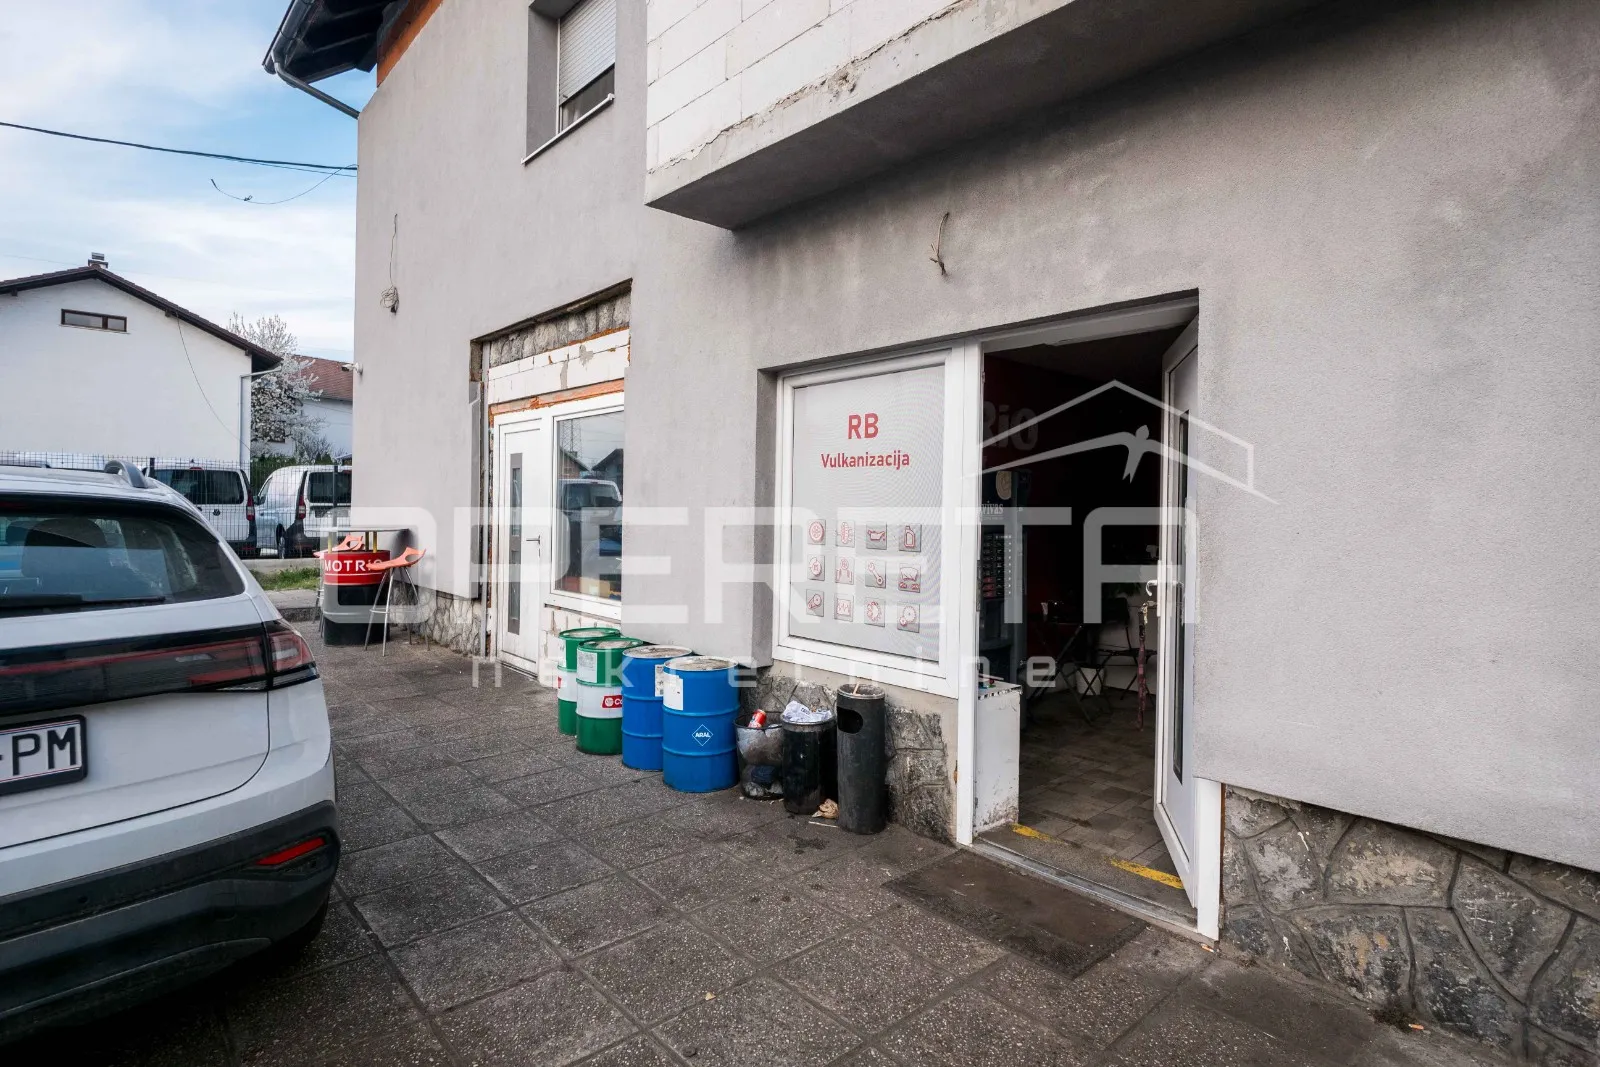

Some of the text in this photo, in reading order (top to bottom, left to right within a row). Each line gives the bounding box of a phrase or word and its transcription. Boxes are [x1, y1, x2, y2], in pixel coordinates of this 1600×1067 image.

[847, 412, 880, 440] RB
[820, 449, 911, 471] Vulkanizacija
[694, 731, 711, 739] ARAL
